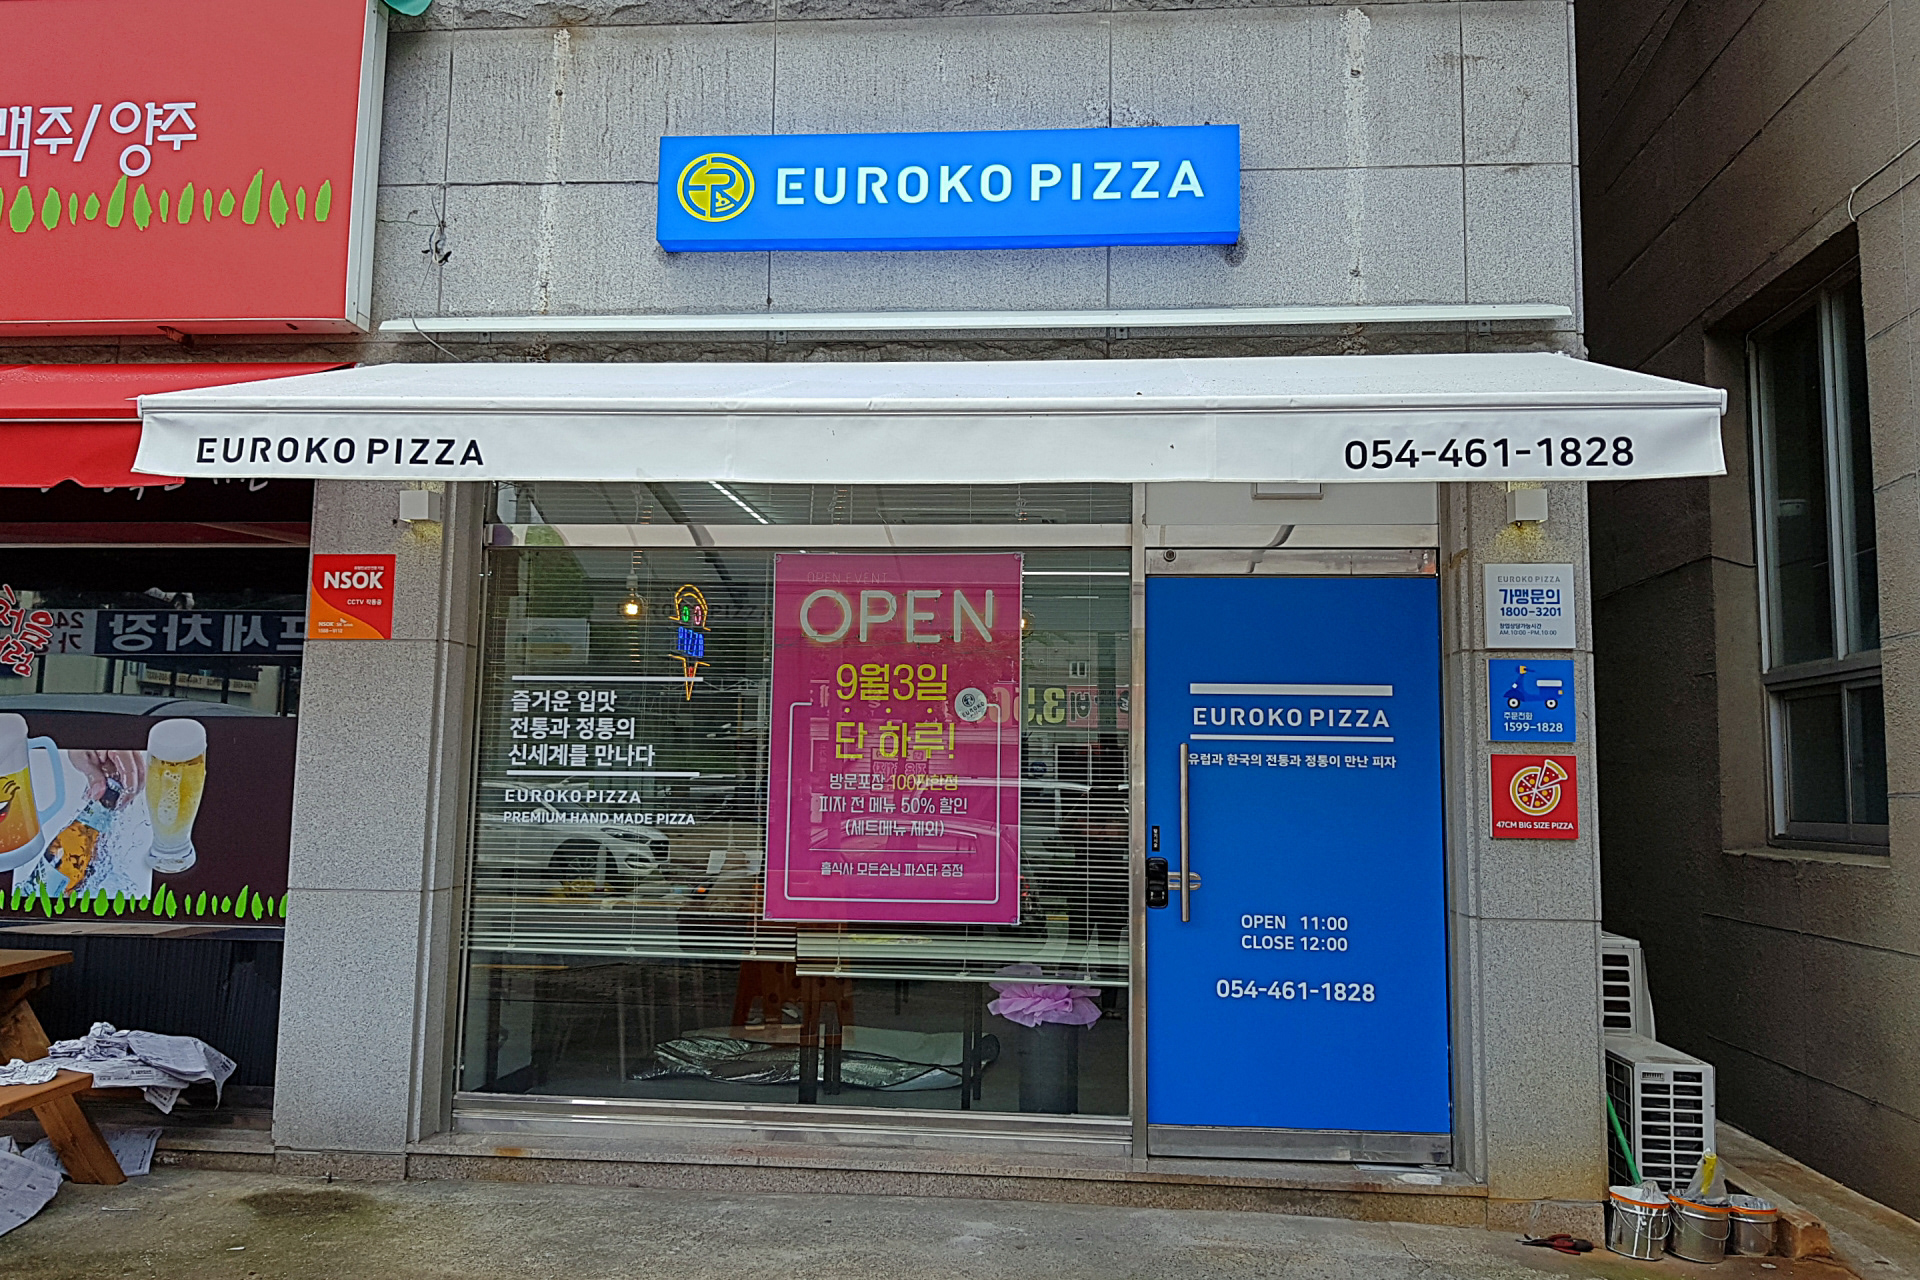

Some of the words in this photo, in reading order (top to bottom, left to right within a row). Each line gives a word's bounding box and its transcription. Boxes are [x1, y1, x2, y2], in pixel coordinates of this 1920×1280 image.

[776, 164, 1012, 206] EUROKO
[1030, 159, 1205, 201] PIZZA
[196, 437, 355, 464] EUROKO
[367, 438, 484, 466] PIZZA
[1345, 436, 1634, 469] 054-461-1828
[323, 571, 384, 589] NSOK
[807, 572, 840, 584] OPEN
[846, 572, 888, 584] EVENT
[1499, 588, 1560, 604] 가맹문의
[800, 589, 993, 643] OPEN
[1500, 607, 1561, 616] 1800-3201
[677, 626, 704, 658] PIZZA
[836, 664, 948, 700] 9월3일
[511, 690, 572, 712] 즐거운
[578, 690, 617, 712] 입맛
[1193, 707, 1302, 726] EUROKO
[1310, 709, 1390, 728] PIZZA
[510, 717, 570, 739] 전통과
[576, 717, 635, 739] 정통의
[1503, 722, 1563, 732] 1599-1828
[836, 722, 868, 759] 단
[879, 721, 955, 759] 하루!
[508, 744, 589, 766] 신세계를
[595, 744, 655, 767] 만나다
[1188, 753, 1223, 766] 유럽과
[1227, 753, 1262, 767] 한국의
[1305, 755, 1340, 768] 정통이
[1345, 755, 1368, 768] 만난
[1372, 756, 1396, 769] 피자
[829, 774, 885, 790] 방문포장
[505, 789, 581, 803] EUROKO
[586, 790, 641, 803] PIZZA
[819, 796, 846, 812] 피자
[851, 797, 864, 813] 전
[869, 797, 896, 813] 메뉴
[901, 798, 936, 813] 50%
[940, 798, 968, 814] 할인
[503, 811, 566, 823] PREMIUM
[571, 812, 609, 824] HAND
[613, 813, 652, 824] MADE
[657, 813, 696, 825] PIZZA
[1519, 821, 1533, 829] BIG
[1533, 821, 1550, 829] SIZE
[1552, 822, 1574, 830] PIZZA
[846, 819, 907, 836] (세트메뉴
[910, 820, 945, 836] 제외)
[857, 862, 901, 876] 모든손님
[904, 863, 938, 877] 파스타
[941, 863, 964, 877] 증정
[1241, 914, 1286, 929] OPEN
[1300, 916, 1348, 931] 11:00
[1241, 935, 1295, 950] CLOSE
[1300, 936, 1348, 951] 12:00
[1216, 979, 1376, 1002] 054-461-1828
